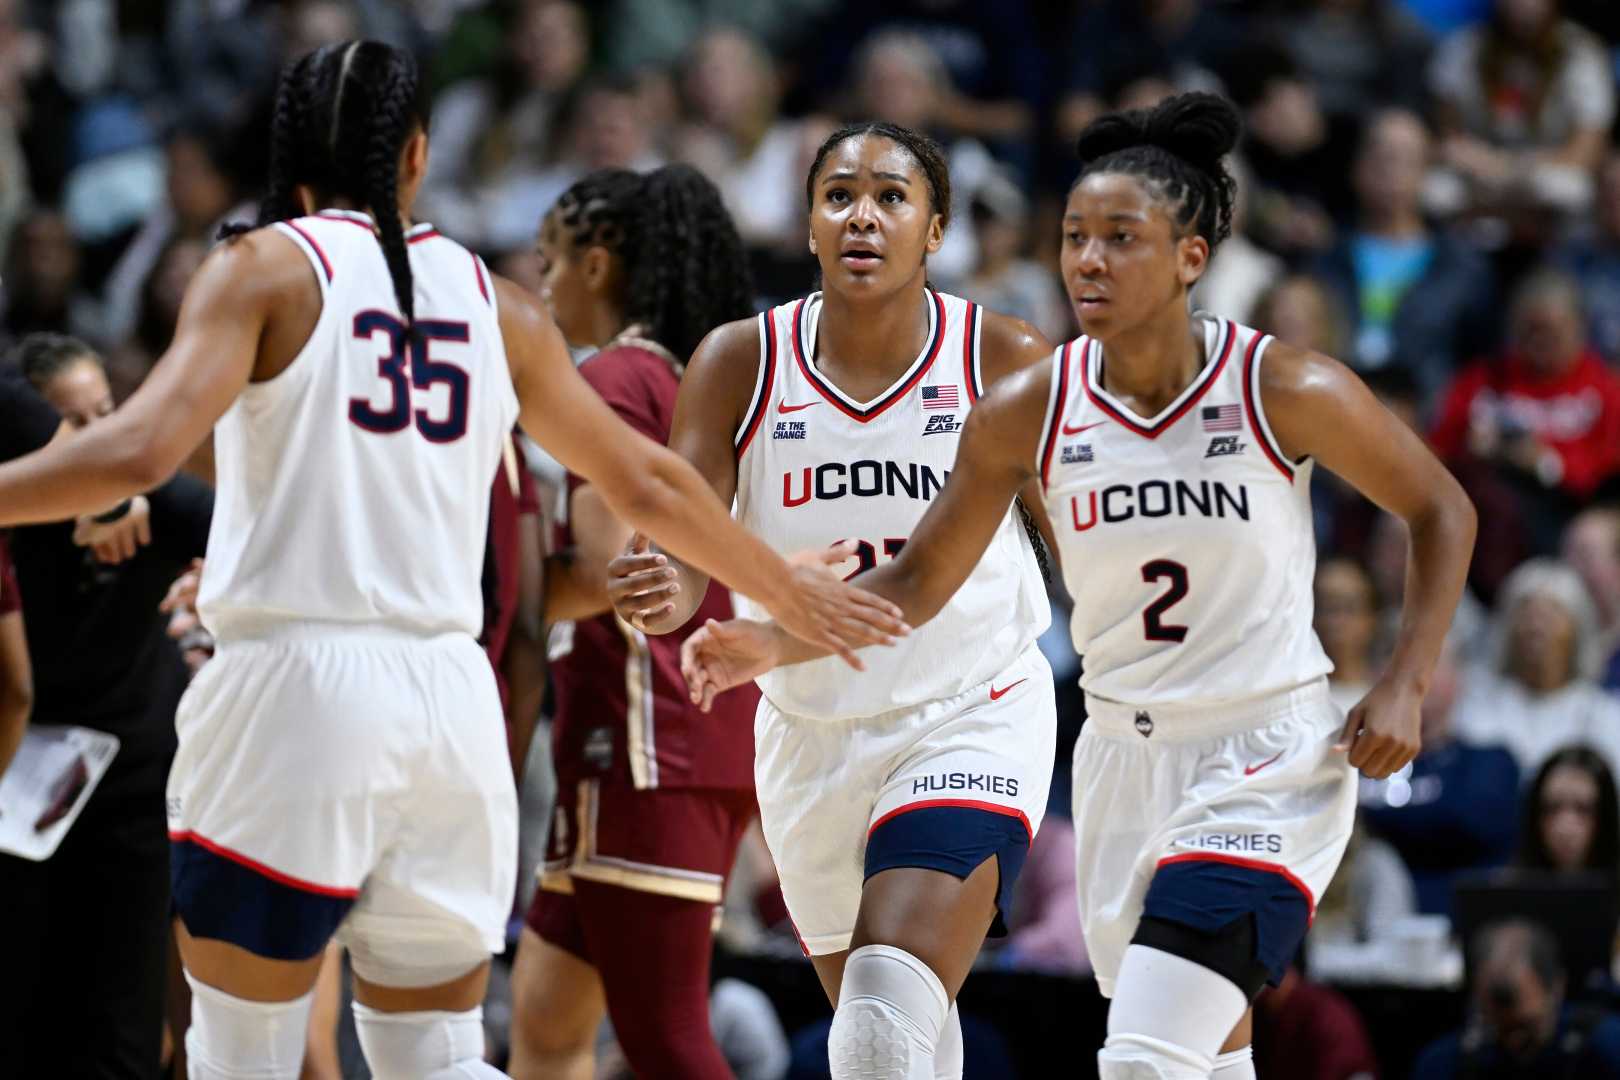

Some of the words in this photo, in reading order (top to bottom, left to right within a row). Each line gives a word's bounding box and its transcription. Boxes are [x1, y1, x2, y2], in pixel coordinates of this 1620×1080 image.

[348, 308, 470, 444] 35
[776, 421, 787, 431] BE
[789, 421, 806, 431] THE
[924, 422, 963, 432] EAST
[928, 414, 956, 424] BIG
[773, 430, 807, 440] CHANGE
[1071, 479, 1250, 532] UCONN
[1141, 559, 1189, 644] 2
[912, 772, 1020, 797] HUSKIES
